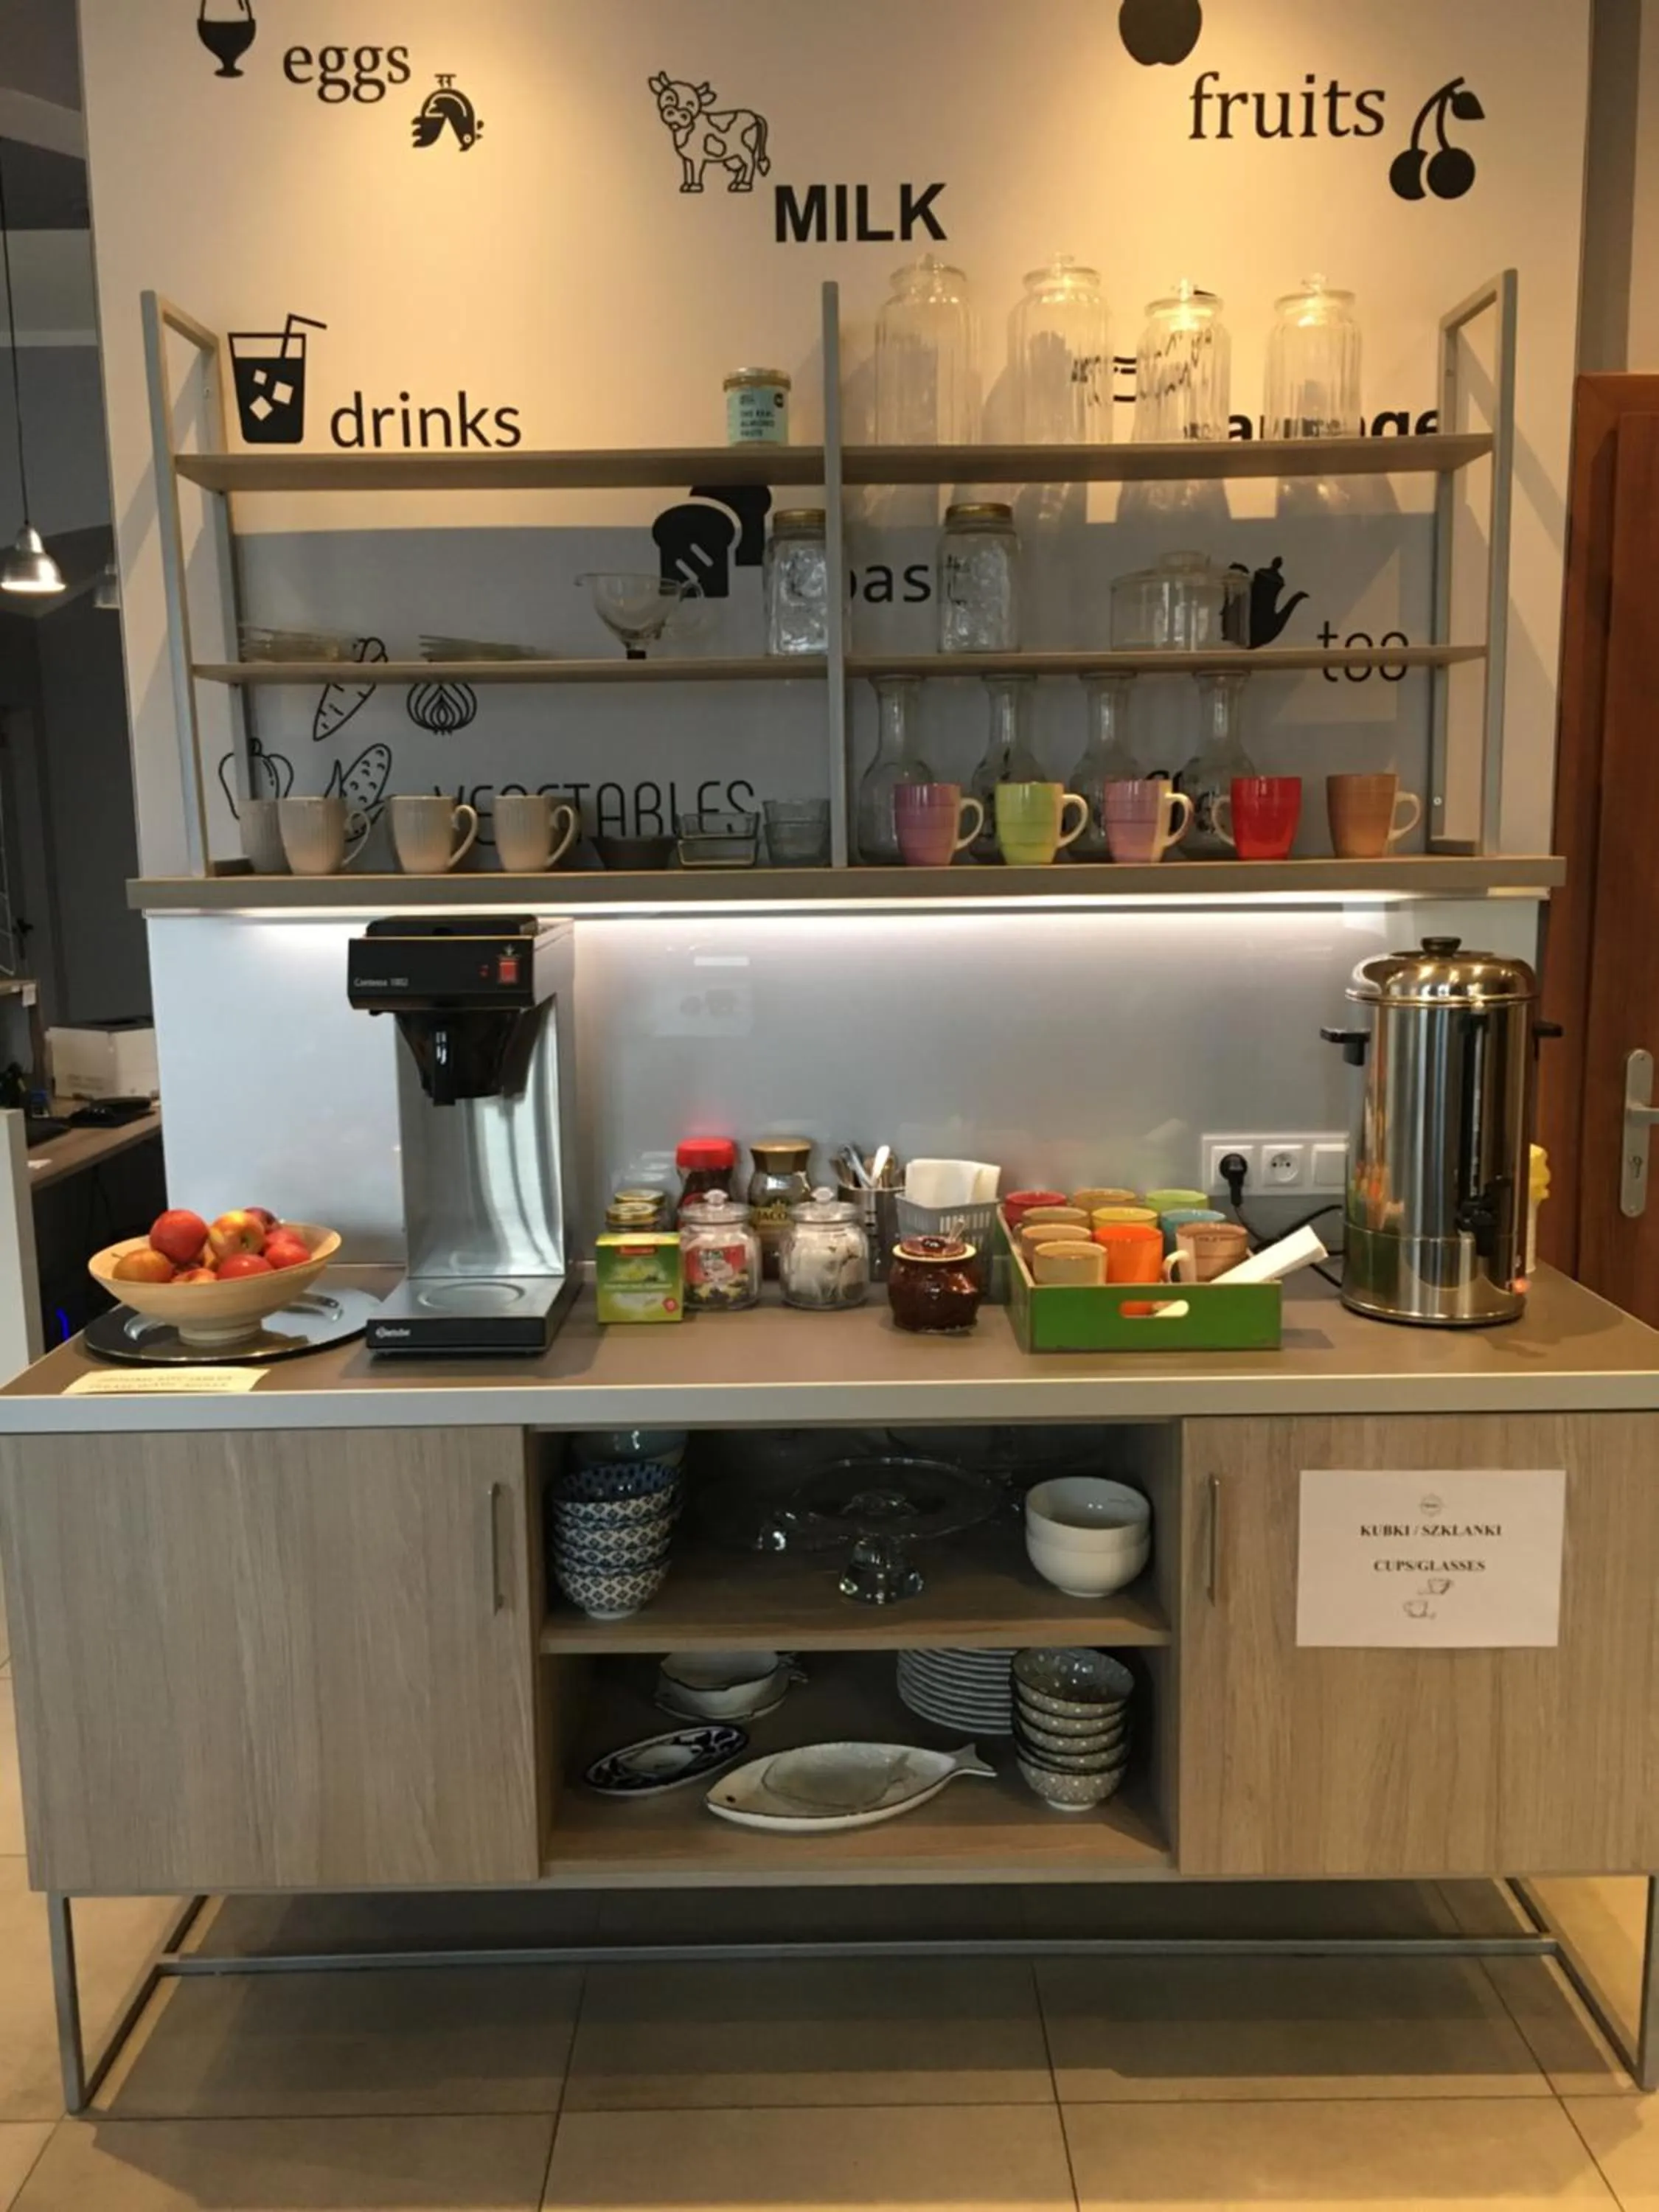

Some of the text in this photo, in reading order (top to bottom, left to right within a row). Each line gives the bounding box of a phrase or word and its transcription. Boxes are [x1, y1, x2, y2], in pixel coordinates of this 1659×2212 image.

[283, 44, 411, 103] eggs
[1188, 72, 1386, 140] fruits
[775, 183, 947, 243] MILK
[330, 391, 522, 448] drinks
[1360, 1524, 1410, 1537] KUBKI
[1421, 1524, 1502, 1537] SZKLANKI
[1373, 1559, 1486, 1572] CUPS/GLASSES
